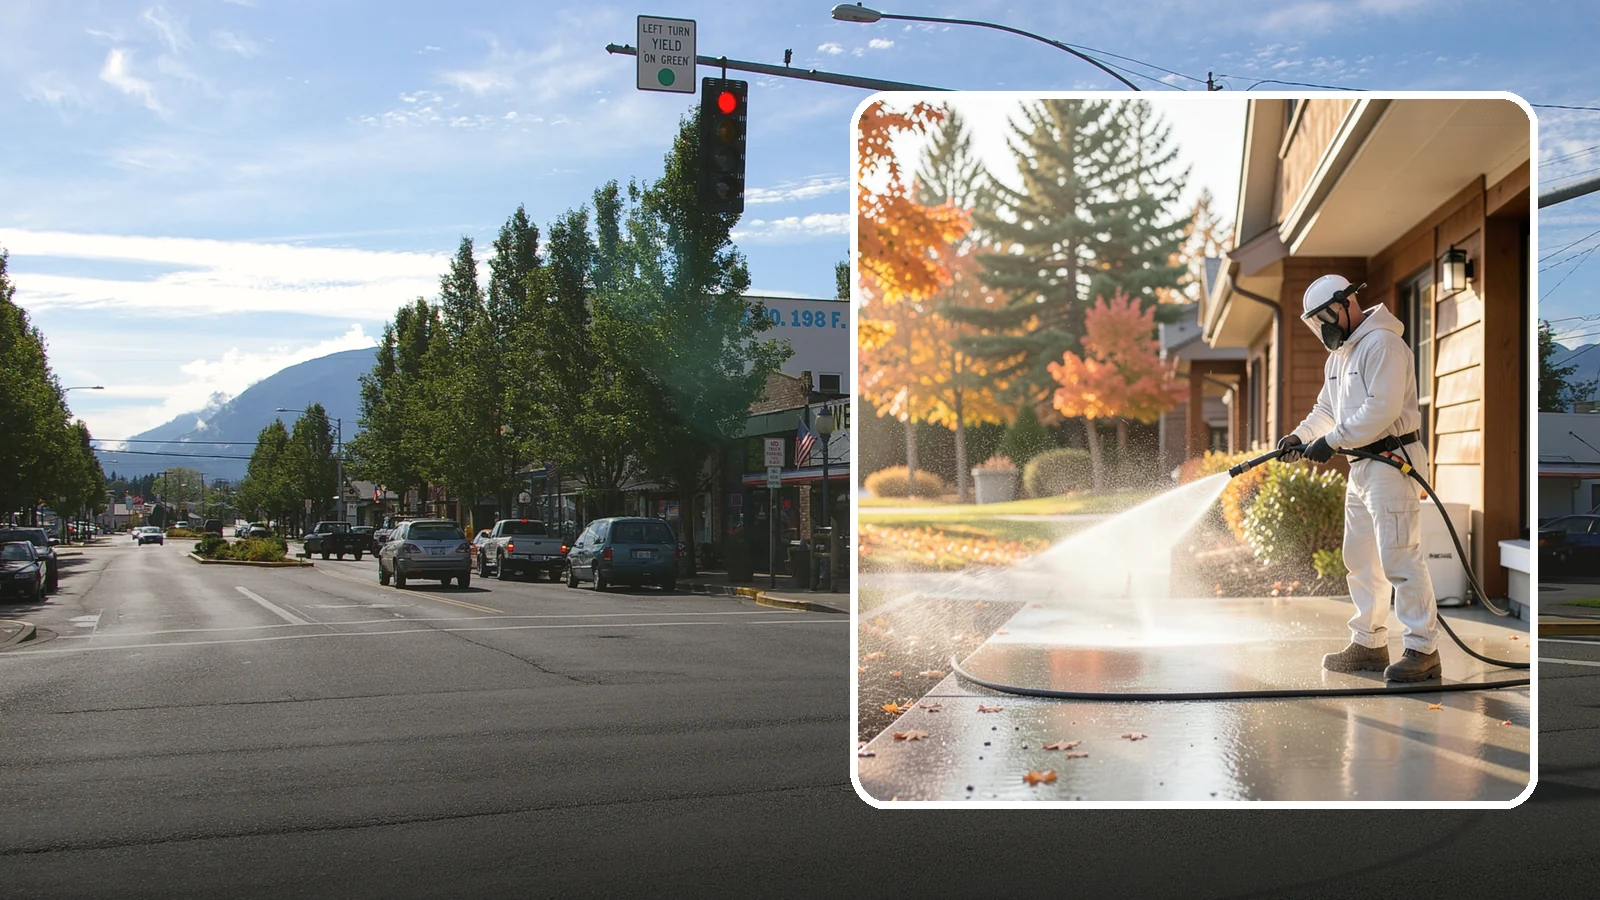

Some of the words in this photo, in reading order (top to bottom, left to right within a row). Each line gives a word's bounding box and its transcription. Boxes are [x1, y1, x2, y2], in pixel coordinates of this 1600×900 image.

[643, 24, 663, 34] LEFT
[668, 26, 690, 36] TURN
[652, 38, 682, 52] YIELD
[791, 310, 826, 328] 198
[831, 311, 846, 328] F.
